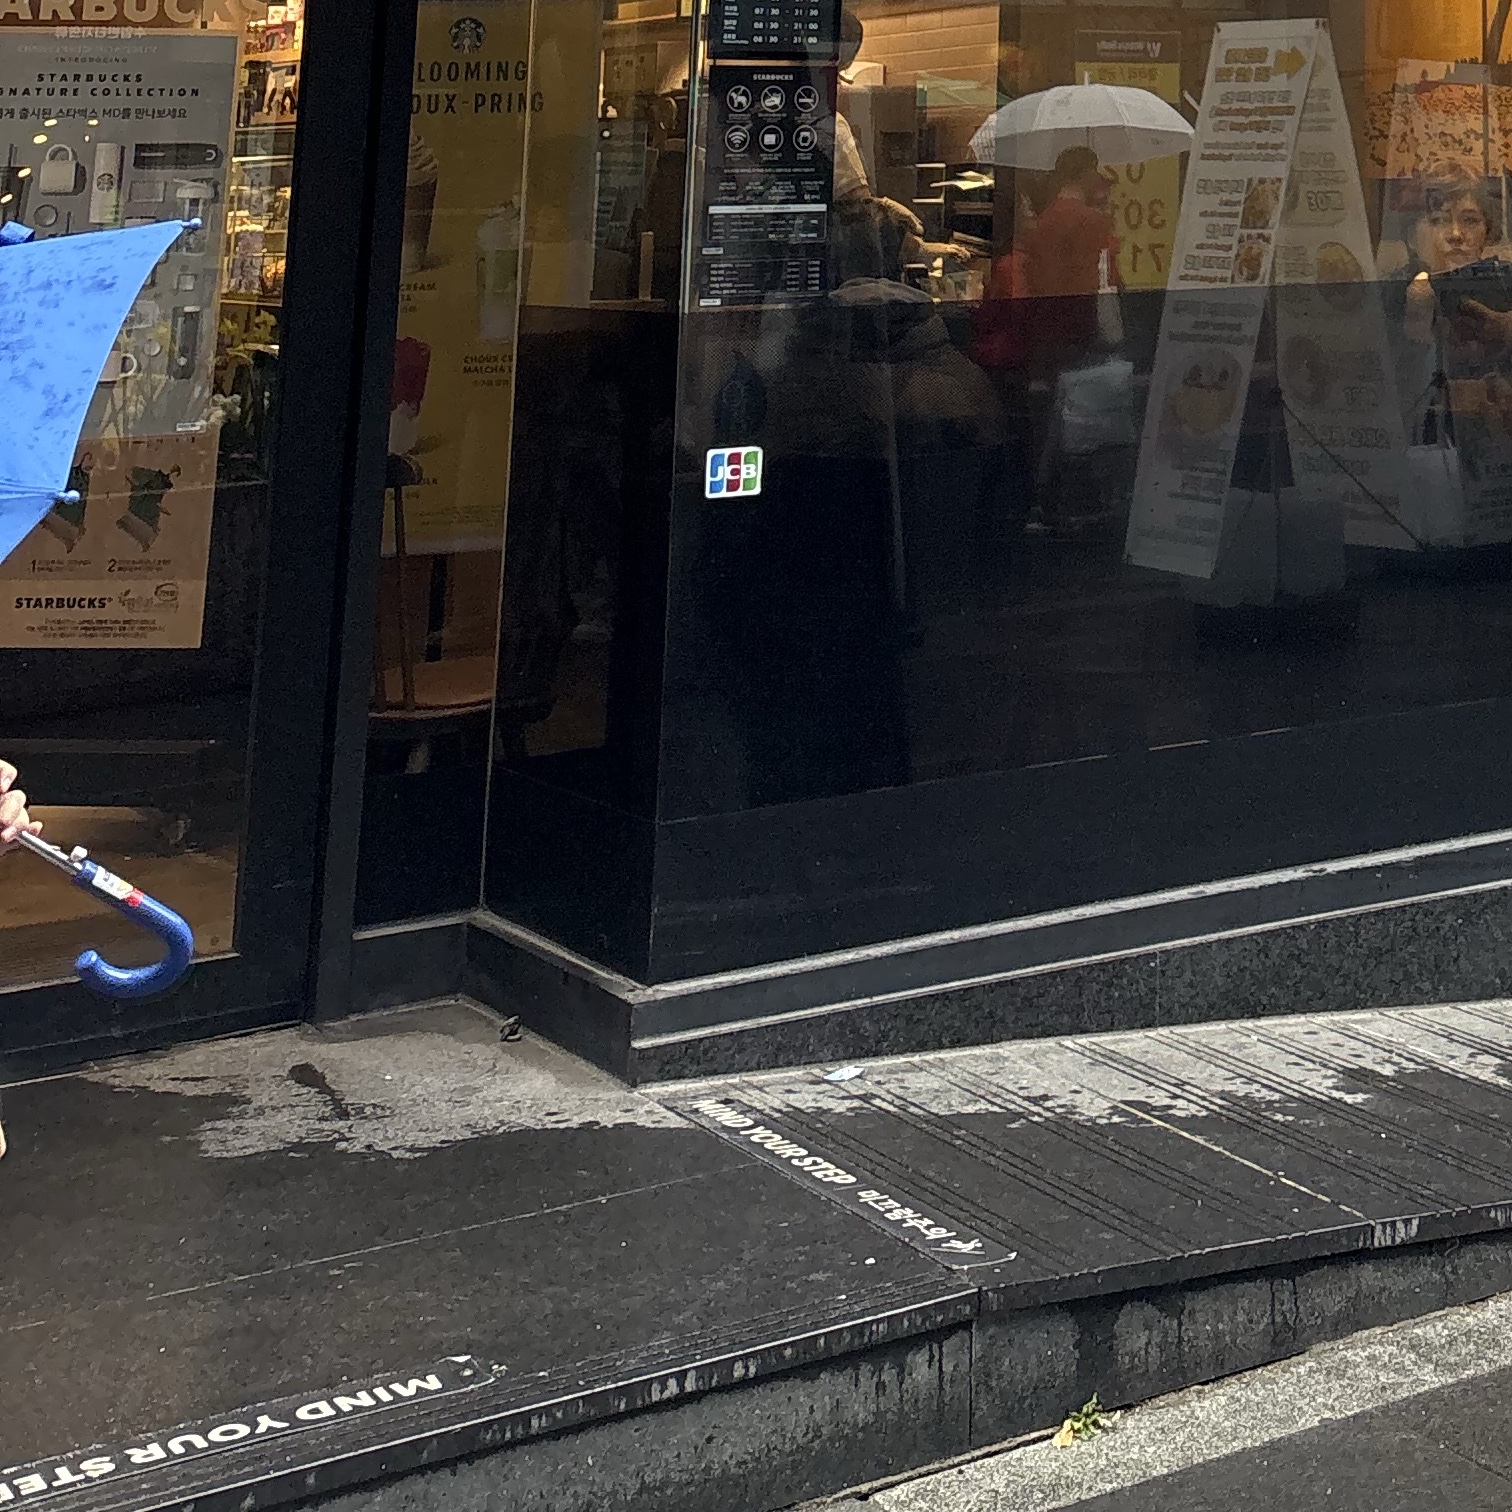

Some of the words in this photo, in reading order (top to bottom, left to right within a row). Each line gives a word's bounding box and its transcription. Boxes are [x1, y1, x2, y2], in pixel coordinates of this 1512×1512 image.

[37, 73, 144, 83] STARBUCKS
[90, 88, 200, 97] COLLECTION
[14, 597, 108, 610] STARBUCKS
[687, 1099, 755, 1130] MIND
[740, 1125, 808, 1159] YOUR
[791, 1155, 857, 1186] STEP
[295, 1374, 444, 1422] MIND
[124, 1414, 291, 1466] YOUR
